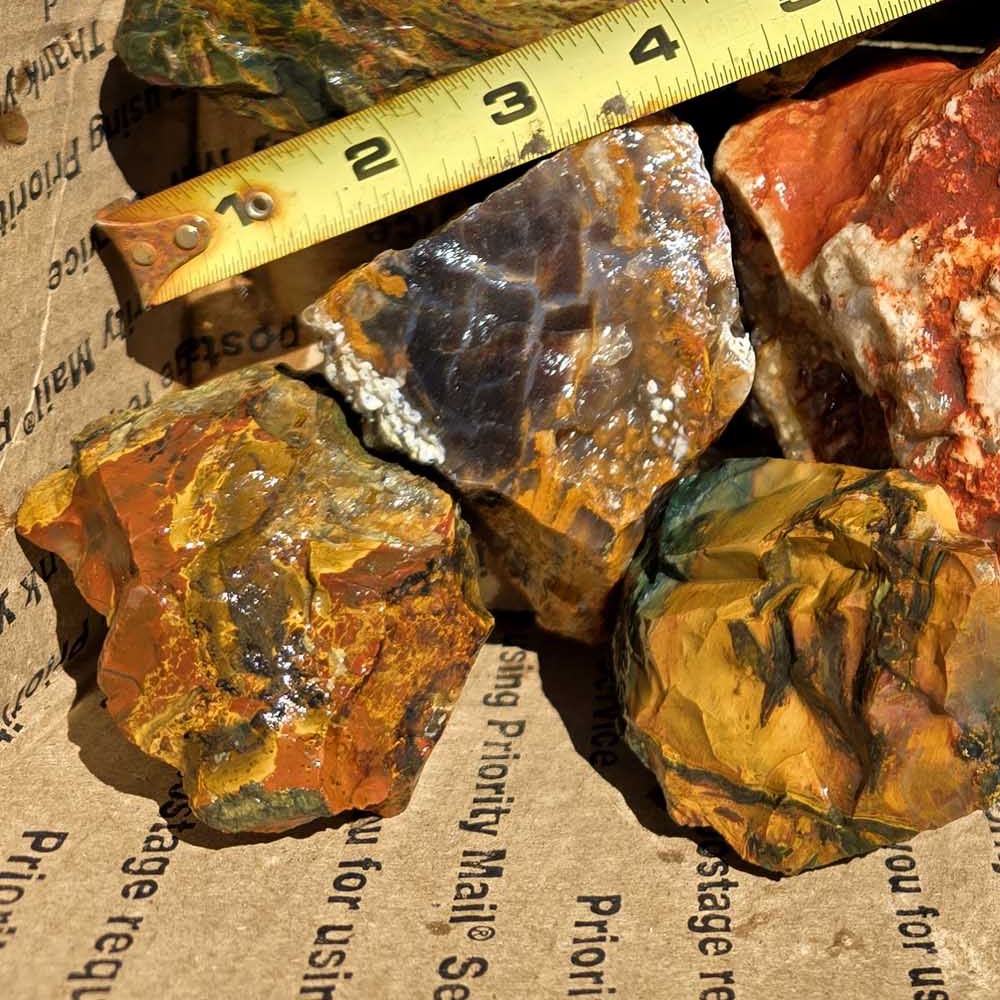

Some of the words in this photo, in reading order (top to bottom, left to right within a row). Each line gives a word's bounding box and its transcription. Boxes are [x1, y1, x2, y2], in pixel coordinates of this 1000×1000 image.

[22, 17, 107, 101] Thank
[214, 192, 256, 227] 1
[345, 135, 400, 181] 2
[483, 80, 537, 126] 3
[628, 24, 682, 66] 4
[482, 650, 532, 708] sing
[458, 718, 526, 837] Priority
[338, 856, 383, 912] for
[448, 849, 508, 942] Mail®
[895, 905, 941, 955] for
